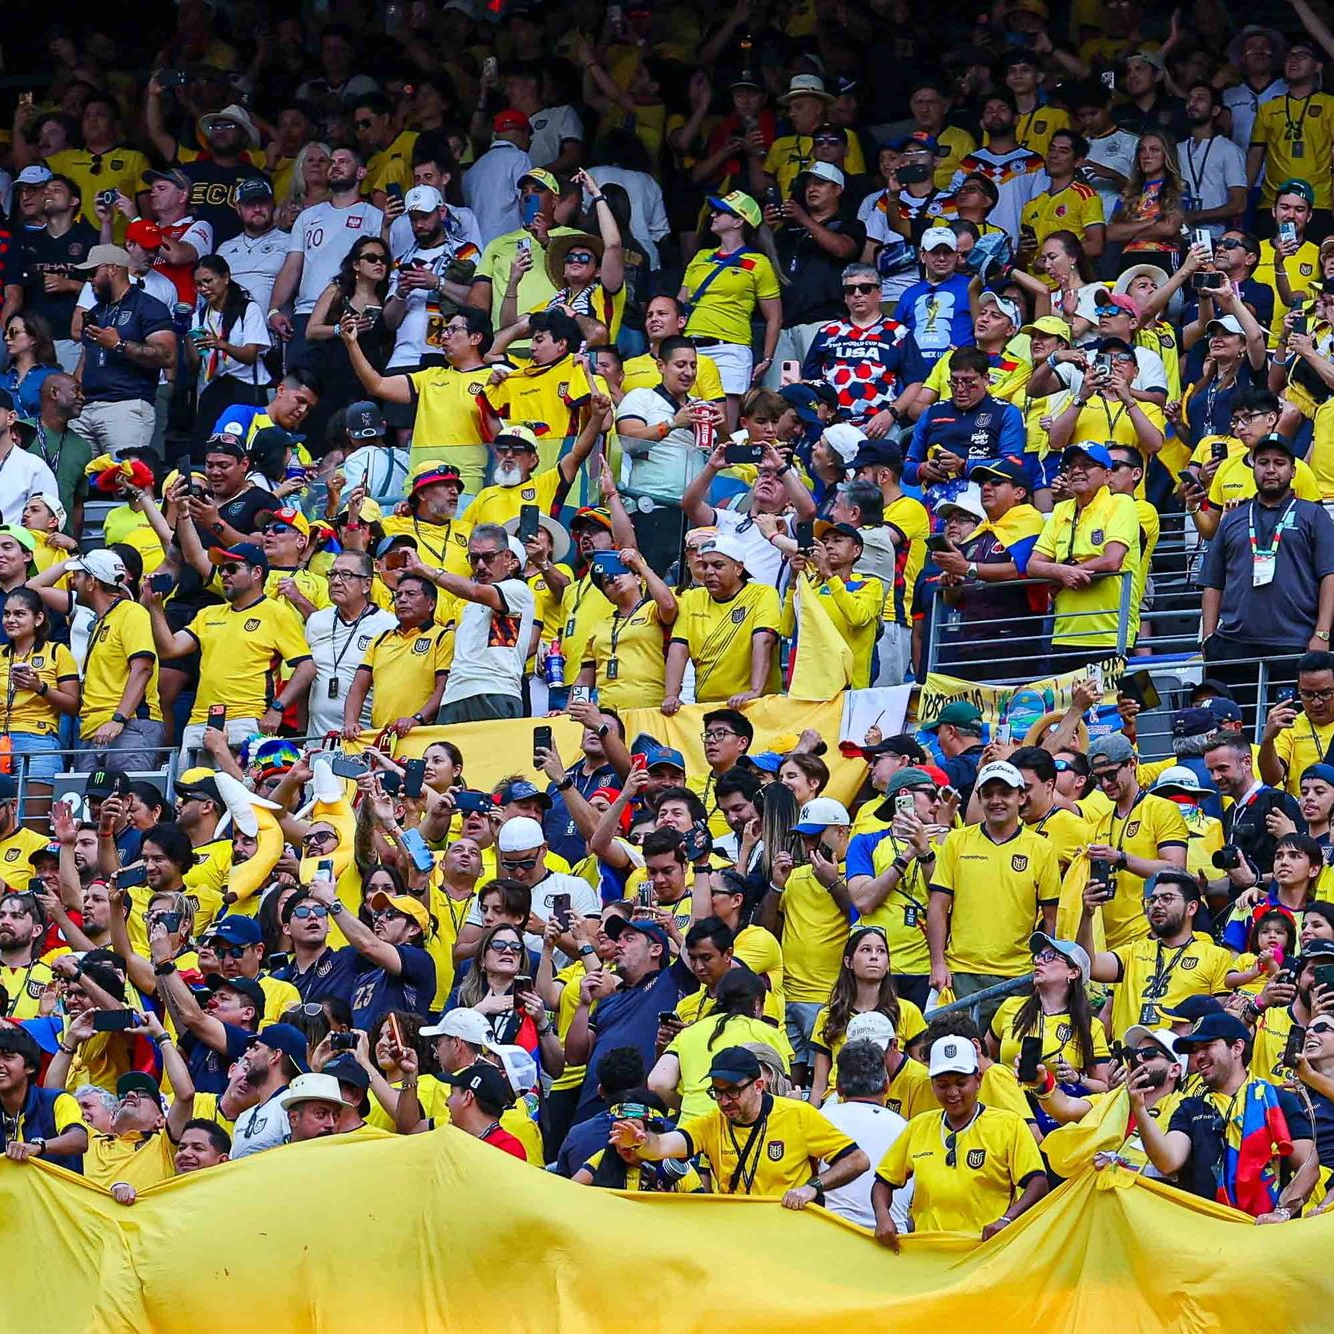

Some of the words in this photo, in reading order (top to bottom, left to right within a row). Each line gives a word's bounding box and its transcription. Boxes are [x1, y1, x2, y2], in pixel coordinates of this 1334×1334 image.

[306, 228, 324, 250] 20
[835, 347, 881, 361] USA
[959, 854, 988, 862] marathon
[353, 983, 377, 1011] 23
